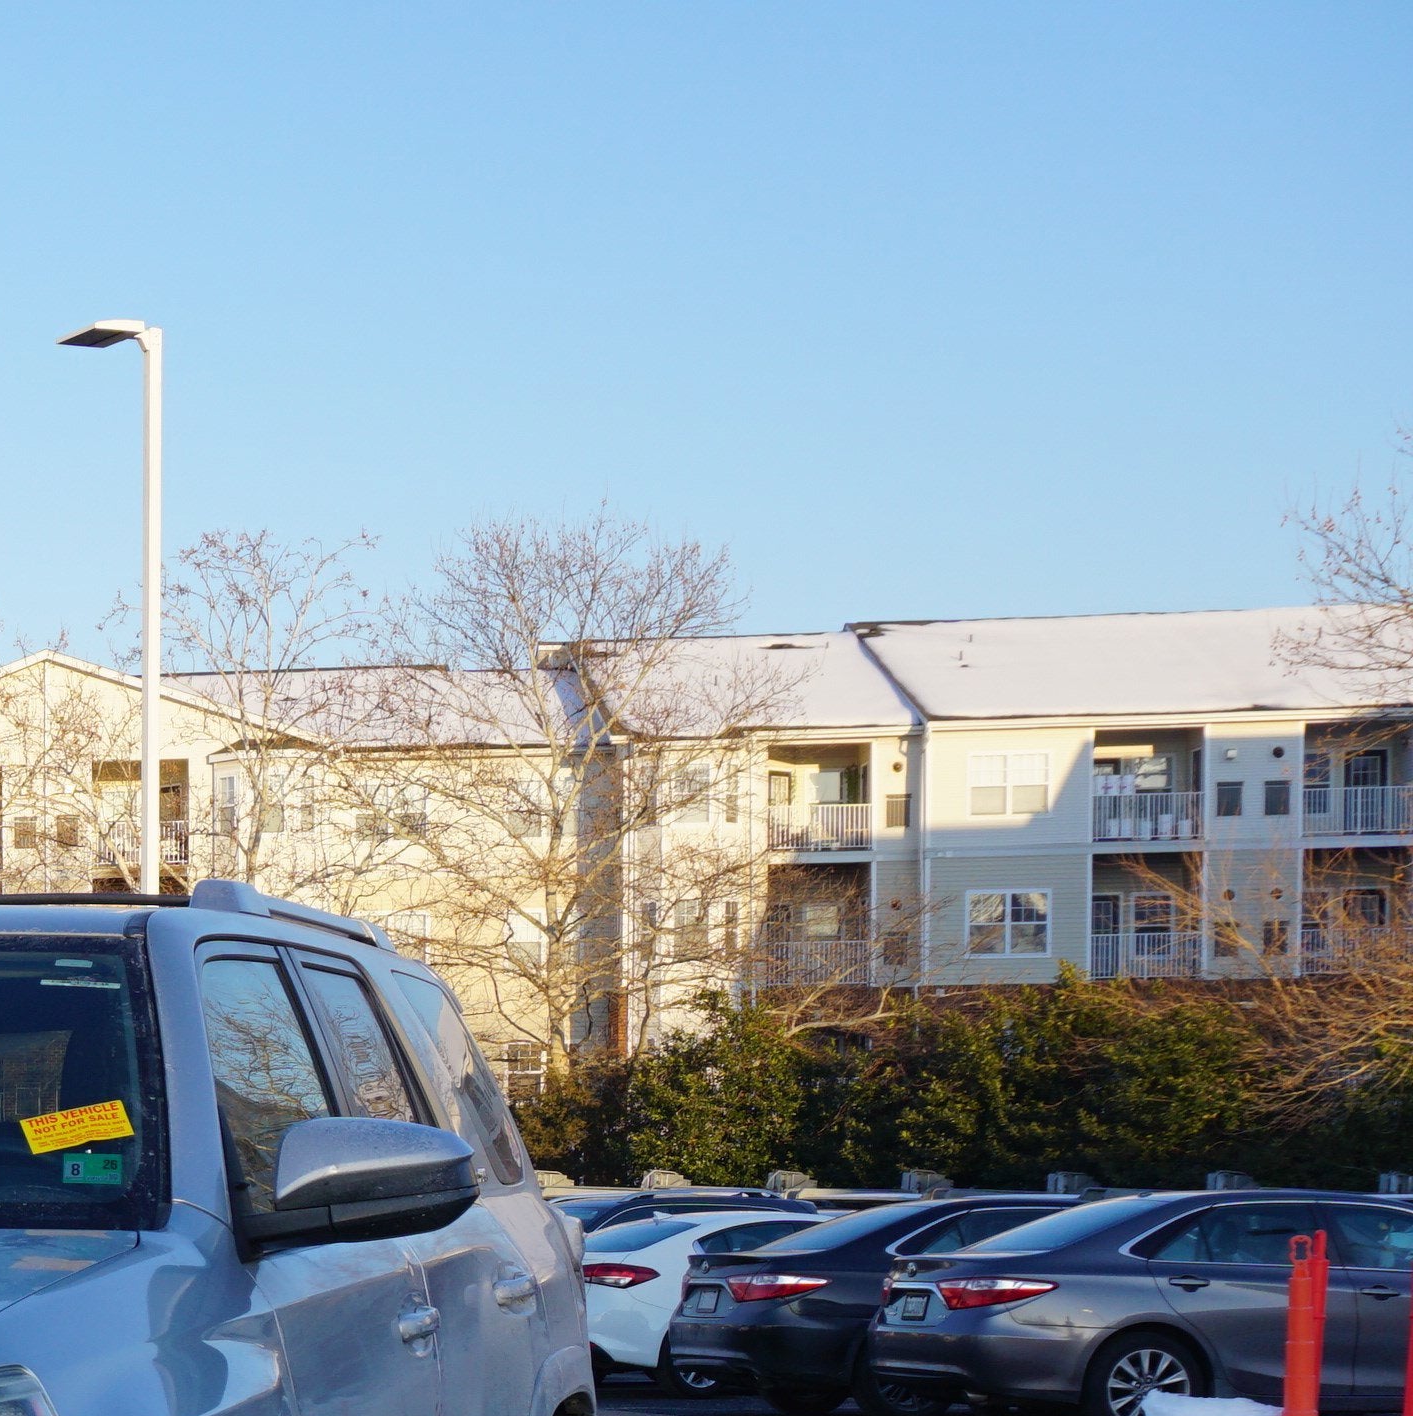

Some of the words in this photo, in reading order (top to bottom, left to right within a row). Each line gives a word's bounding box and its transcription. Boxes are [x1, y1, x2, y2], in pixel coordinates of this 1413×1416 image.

[26, 1115, 58, 1128] THIS
[61, 1102, 119, 1120] VEHICLE
[34, 1126, 57, 1135] NOT
[61, 1118, 85, 1129] FOR
[89, 1112, 119, 1122] SALE
[71, 1163, 80, 1176] 8
[103, 1160, 118, 1170] 26
